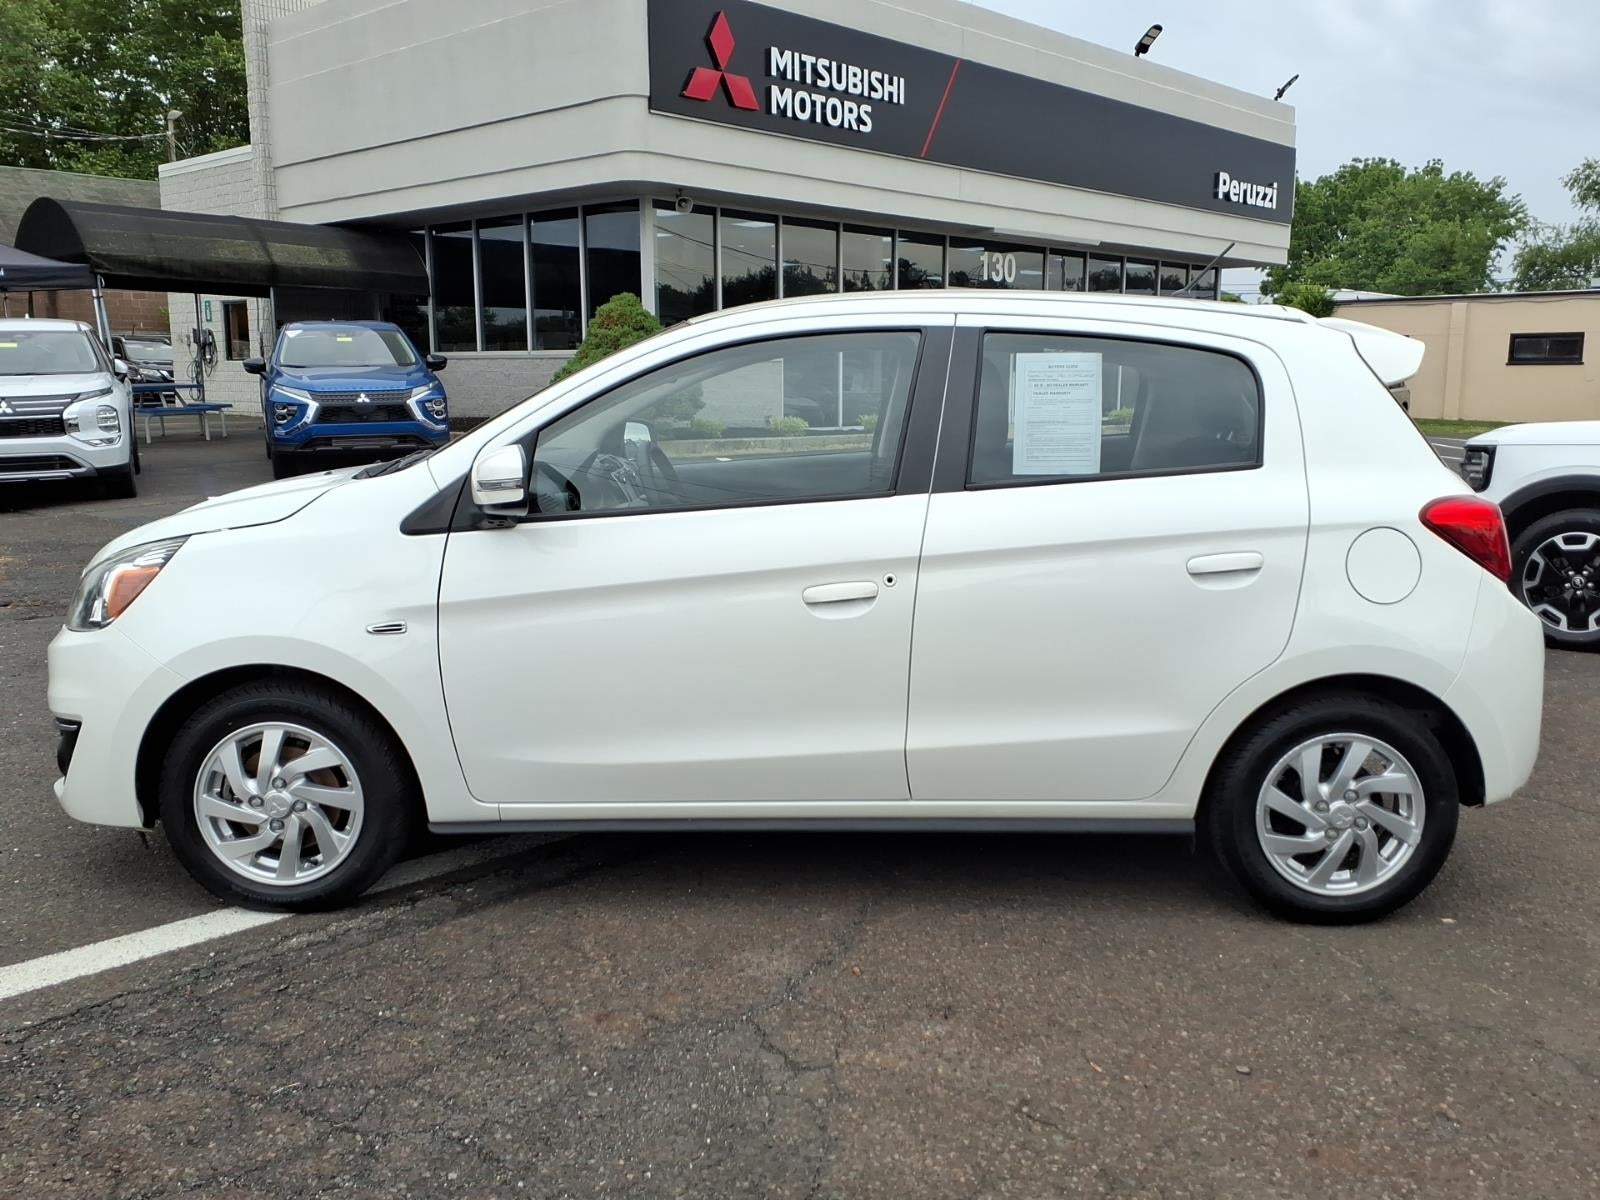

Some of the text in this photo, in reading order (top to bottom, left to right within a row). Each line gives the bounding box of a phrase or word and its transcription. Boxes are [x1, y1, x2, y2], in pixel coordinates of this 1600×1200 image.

[770, 46, 905, 105] MITSUBISHI
[770, 84, 872, 133] MOTORS
[1218, 171, 1278, 210] Peruzzi
[980, 251, 1016, 283] 130
